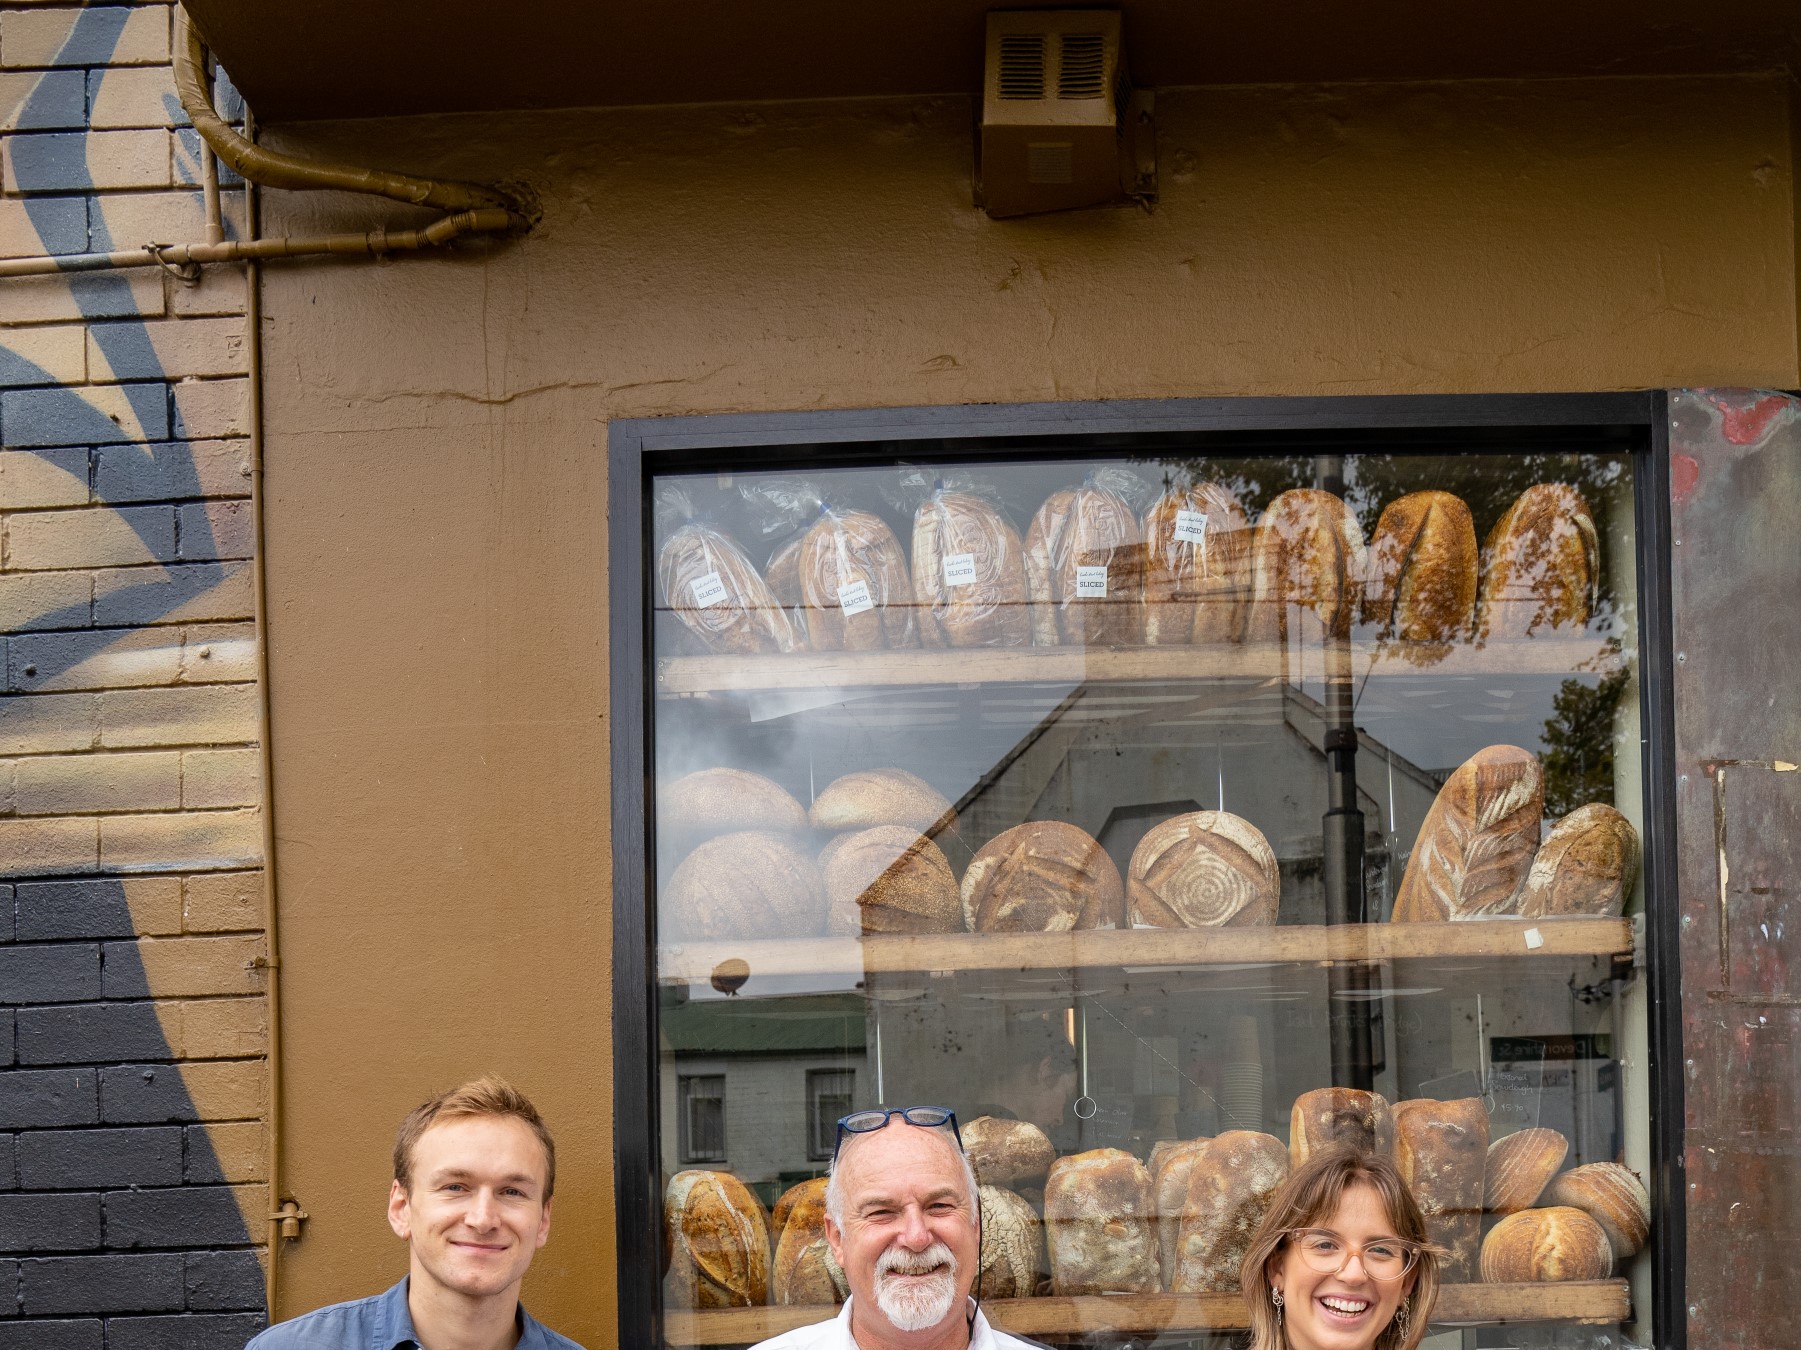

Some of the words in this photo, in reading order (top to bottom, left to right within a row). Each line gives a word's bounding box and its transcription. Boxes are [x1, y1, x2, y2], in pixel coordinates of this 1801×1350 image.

[1178, 526, 1202, 534] SLICED
[948, 568, 972, 577] SLICED
[698, 586, 722, 600] SLICED
[844, 595, 868, 608] SLICED
